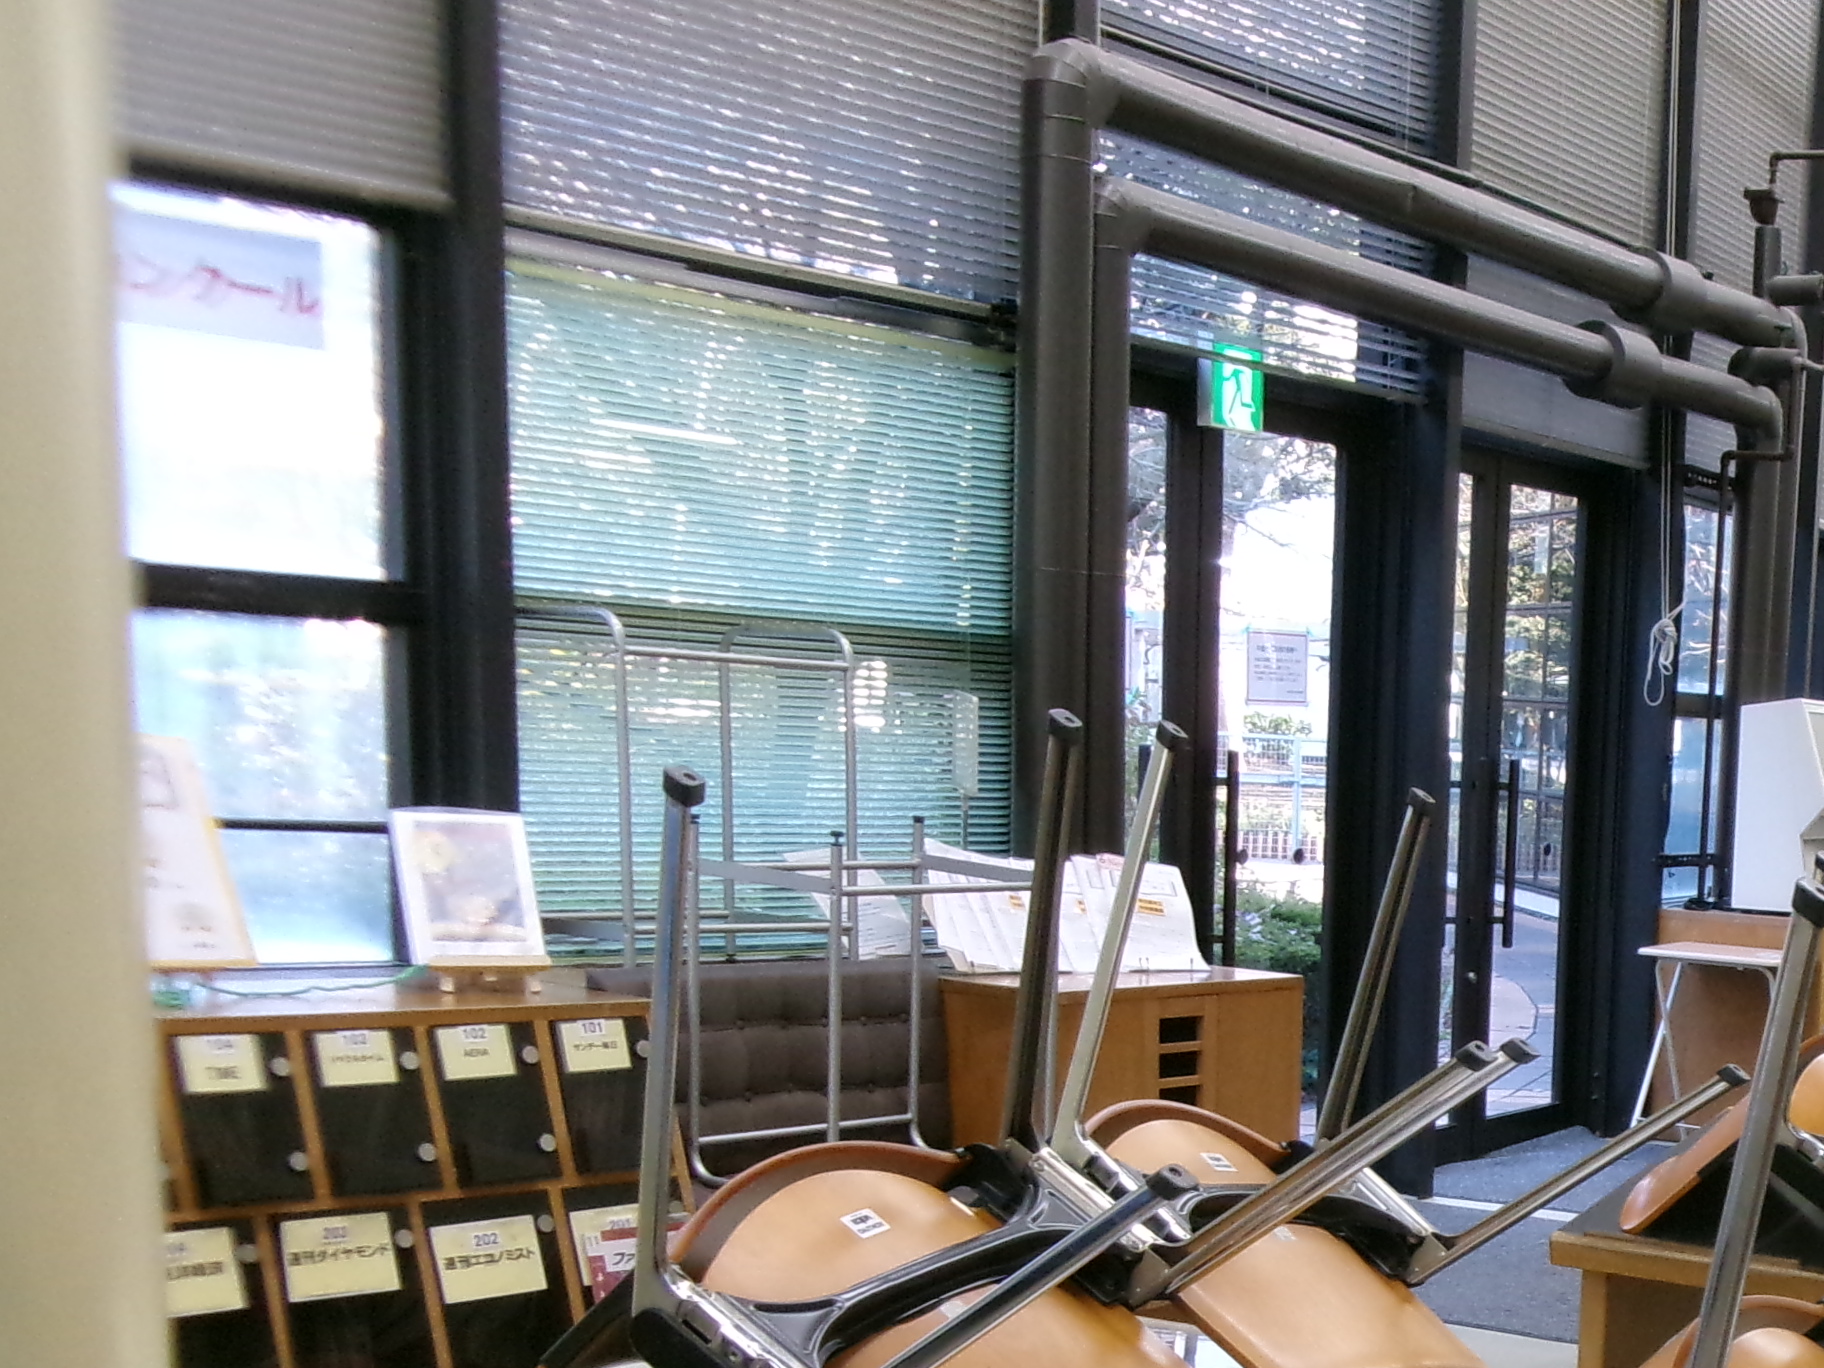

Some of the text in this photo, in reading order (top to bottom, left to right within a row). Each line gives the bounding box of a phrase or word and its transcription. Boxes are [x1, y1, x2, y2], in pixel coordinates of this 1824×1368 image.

[463, 1027, 488, 1040] 102
[581, 1022, 604, 1035] 101
[474, 1232, 500, 1247] 202
[442, 1247, 535, 1271] 週刊エコノミスト
